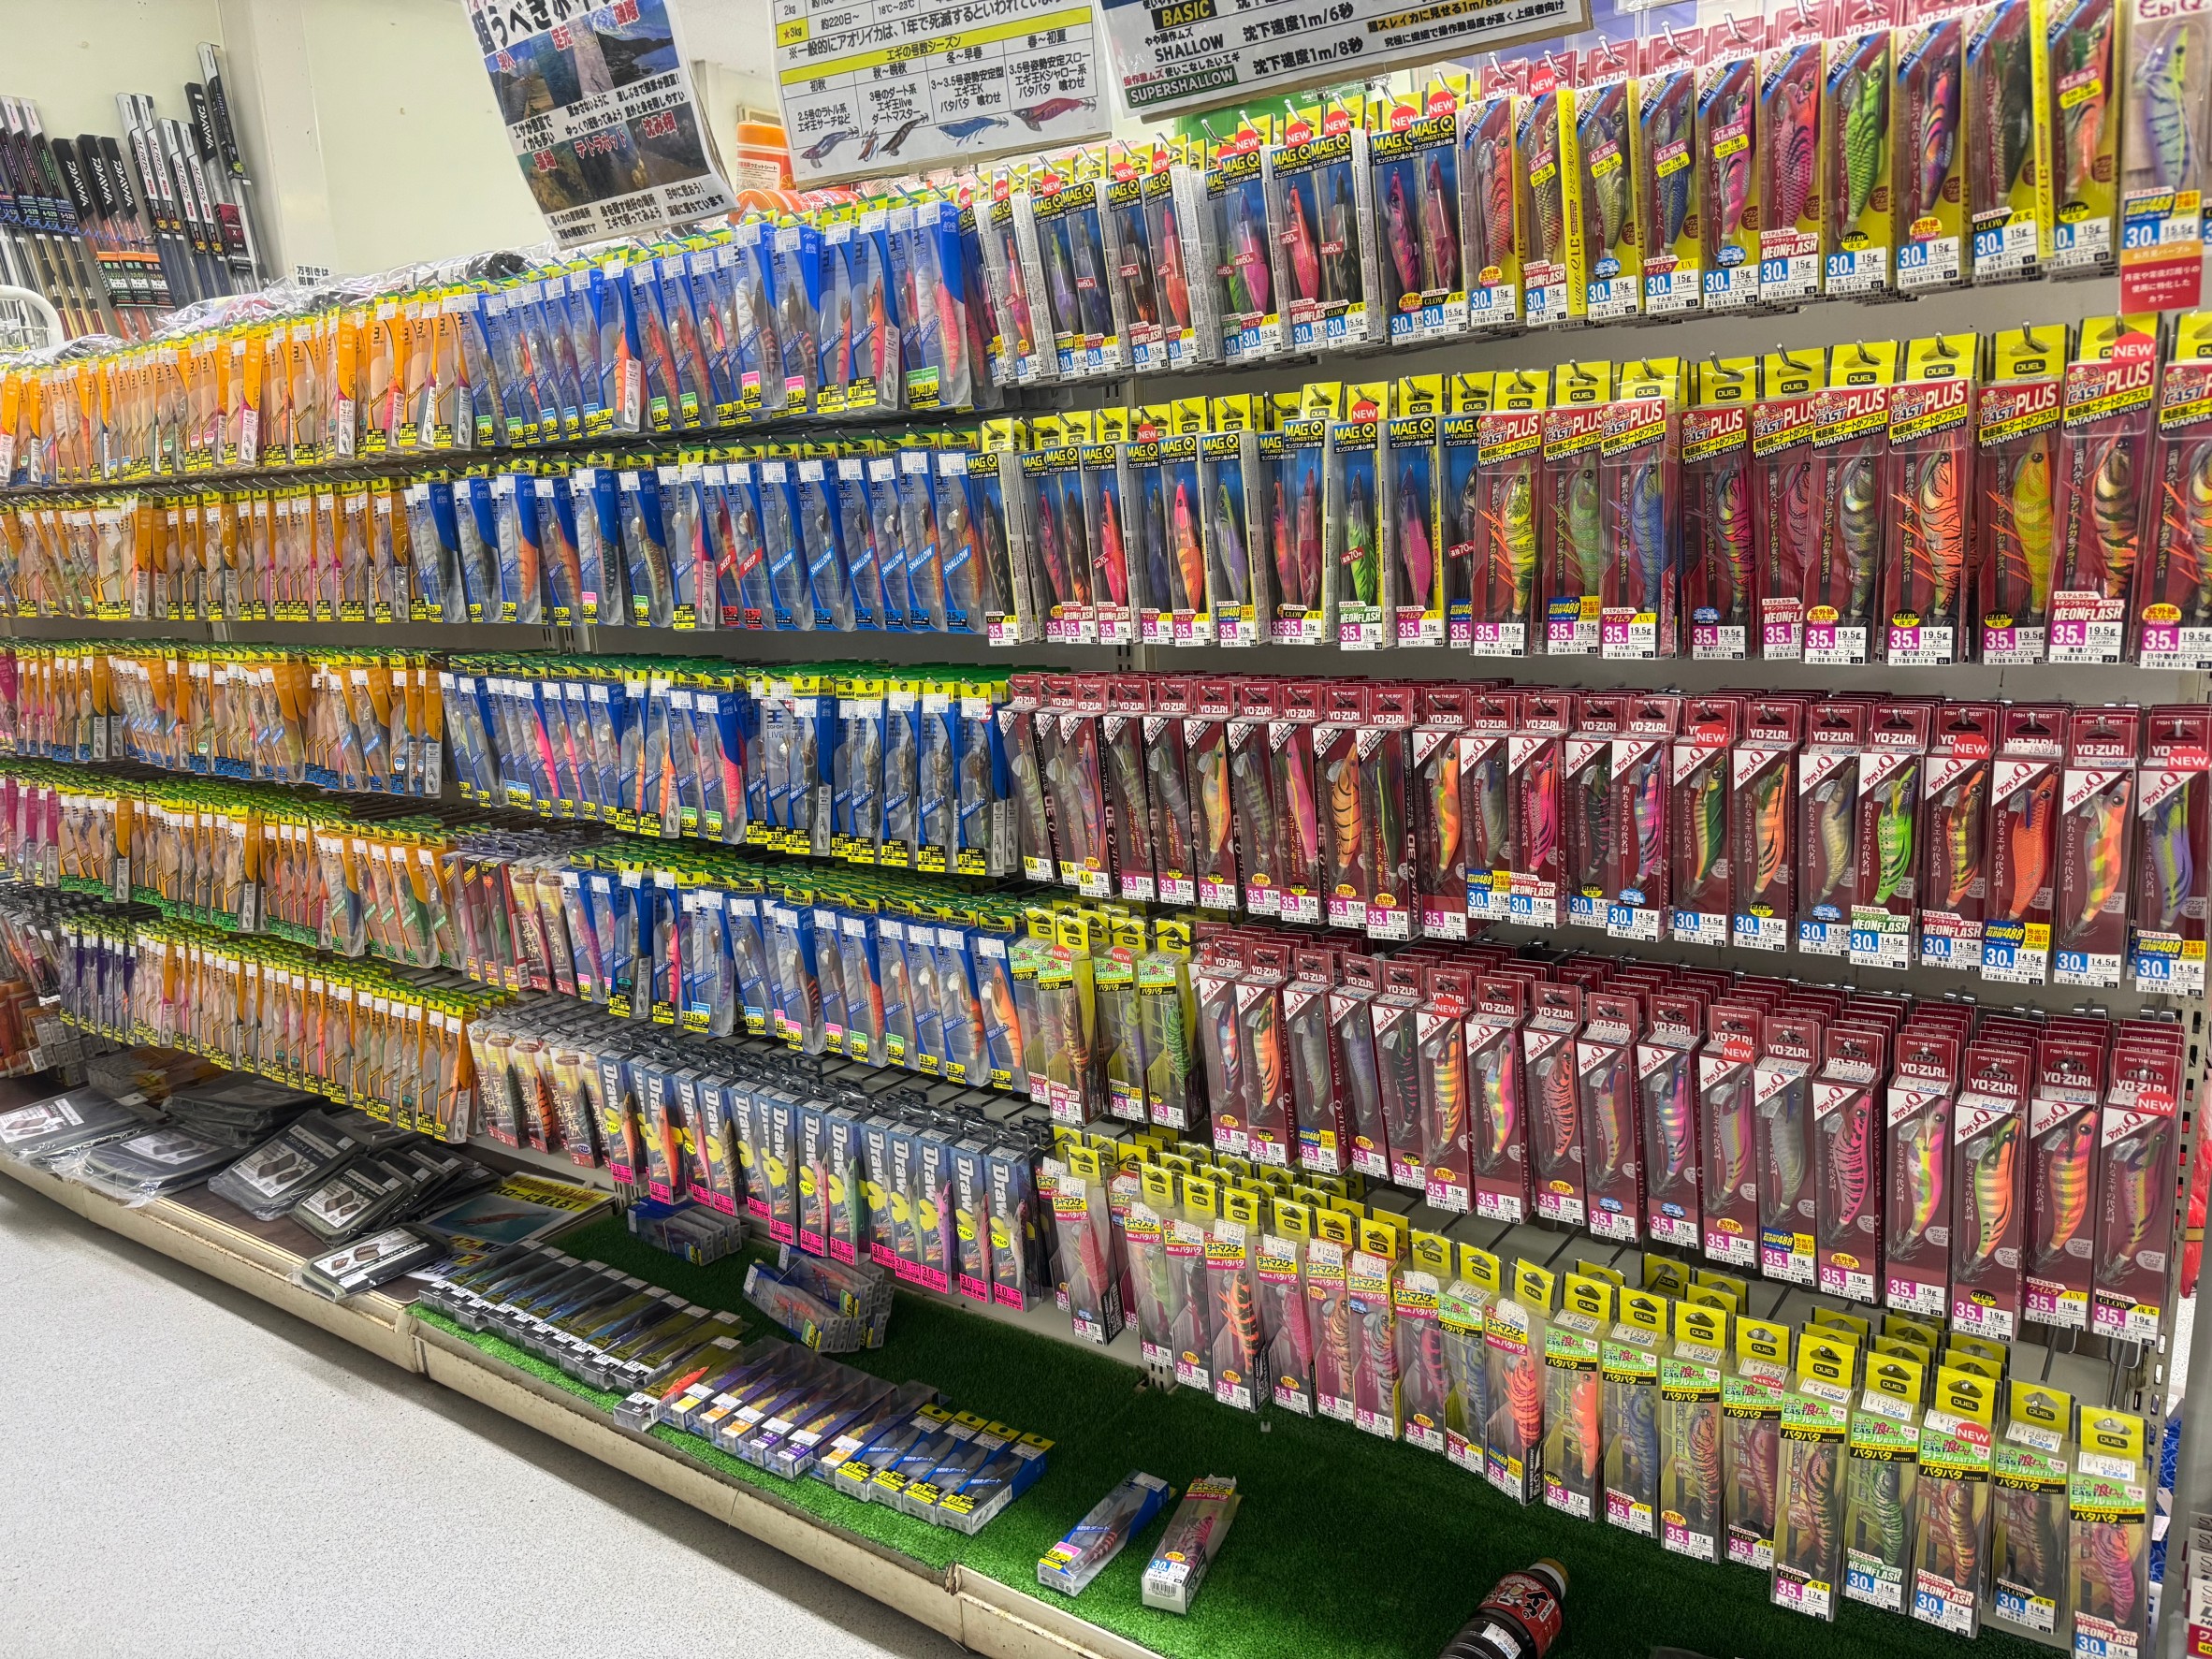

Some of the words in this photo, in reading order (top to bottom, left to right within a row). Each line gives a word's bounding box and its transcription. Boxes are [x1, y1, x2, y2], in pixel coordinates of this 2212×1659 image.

[1161, 1, 1211, 27] BASIC
[886, 36, 962, 61] エギの号数シーズン
[1155, 34, 1224, 63] SHALLOW
[810, 79, 827, 93] 初秋
[954, 83, 983, 97] エギ王K
[1059, 77, 1085, 91] 喰わせ
[1130, 68, 1235, 103] SUPERSHALLOW
[1531, 78, 1553, 92] NEW
[869, 83, 918, 102] 3号のダート系
[977, 92, 1001, 106] 喰わせ
[878, 97, 912, 112] エギ王live
[1429, 99, 1453, 113] NEW
[798, 103, 847, 122] 2.5号のラトル系
[872, 109, 921, 125] ダートマスター
[196, 104, 214, 150] DAIWA
[642, 111, 677, 139] 沈み根
[798, 114, 851, 132] エギ王サーチなど
[1325, 118, 1347, 131] NEW
[522, 132, 556, 152] イカも多い
[1153, 158, 1169, 169] NEW
[65, 160, 90, 207] DAIWA
[92, 157, 113, 205] DAIWA
[112, 159, 134, 207] DAIWA
[1976, 219, 2004, 231] GLOW
[2014, 210, 2032, 223] 夜光
[1762, 240, 1817, 260] NEONFLASH
[1862, 253, 1878, 264] 15g
[1647, 263, 1672, 274] ケイムラ
[1681, 260, 1694, 269] UV
[1525, 269, 1565, 288] NEONFLASH
[1677, 274, 1691, 284] 15g
[1424, 296, 1444, 305] GLOW
[1496, 289, 1508, 298] 15g
[2113, 343, 2153, 357] NEW
[1927, 366, 1951, 375] DUEL
[1850, 373, 1873, 383] DUEL
[1637, 387, 1659, 397] DUEL
[1925, 381, 1965, 405] PLUS
[1411, 404, 1430, 413] DUEL
[1846, 388, 1886, 417] PLUS
[1629, 400, 1663, 429] PLUS
[1891, 429, 1932, 445] PATAPATA
[1939, 419, 1965, 430] PATENT
[1603, 444, 1635, 459] PATAPATA
[1640, 435, 1664, 447] PATENT
[744, 554, 757, 570] DEEP
[944, 548, 968, 575] SHALLOW
[1340, 612, 1381, 624] NEONFLASH
[1605, 614, 1630, 623] ケイムラ
[2054, 606, 2123, 621] NEONFLASH
[1837, 630, 1861, 640] 19.5g
[2088, 625, 2117, 637] 19.5g
[1118, 701, 1145, 711] YO-ZURI
[1329, 709, 1361, 720] YO-ZURI
[1475, 719, 1506, 729] YO-ZURI
[1813, 731, 1854, 742] YO-ZURI
[2075, 744, 2125, 756] YO-ZURI
[965, 847, 980, 855] BASIC
[982, 921, 1011, 933] YAMASHITA
[1215, 957, 1243, 968] YO-ZURI
[2090, 957, 2117, 968] 14.5g
[1435, 1003, 1459, 1014] NEW
[1768, 1043, 1812, 1059] YO-ZURI
[1900, 1063, 1946, 1078] YO-ZURI
[2043, 1071, 2092, 1087] YO-ZURI
[2133, 1314, 2150, 1325] 19g
[1882, 1381, 1905, 1392] DUEL
[1957, 1429, 1989, 1444] NEW
[1918, 1581, 1972, 1607] NEONFLASH
